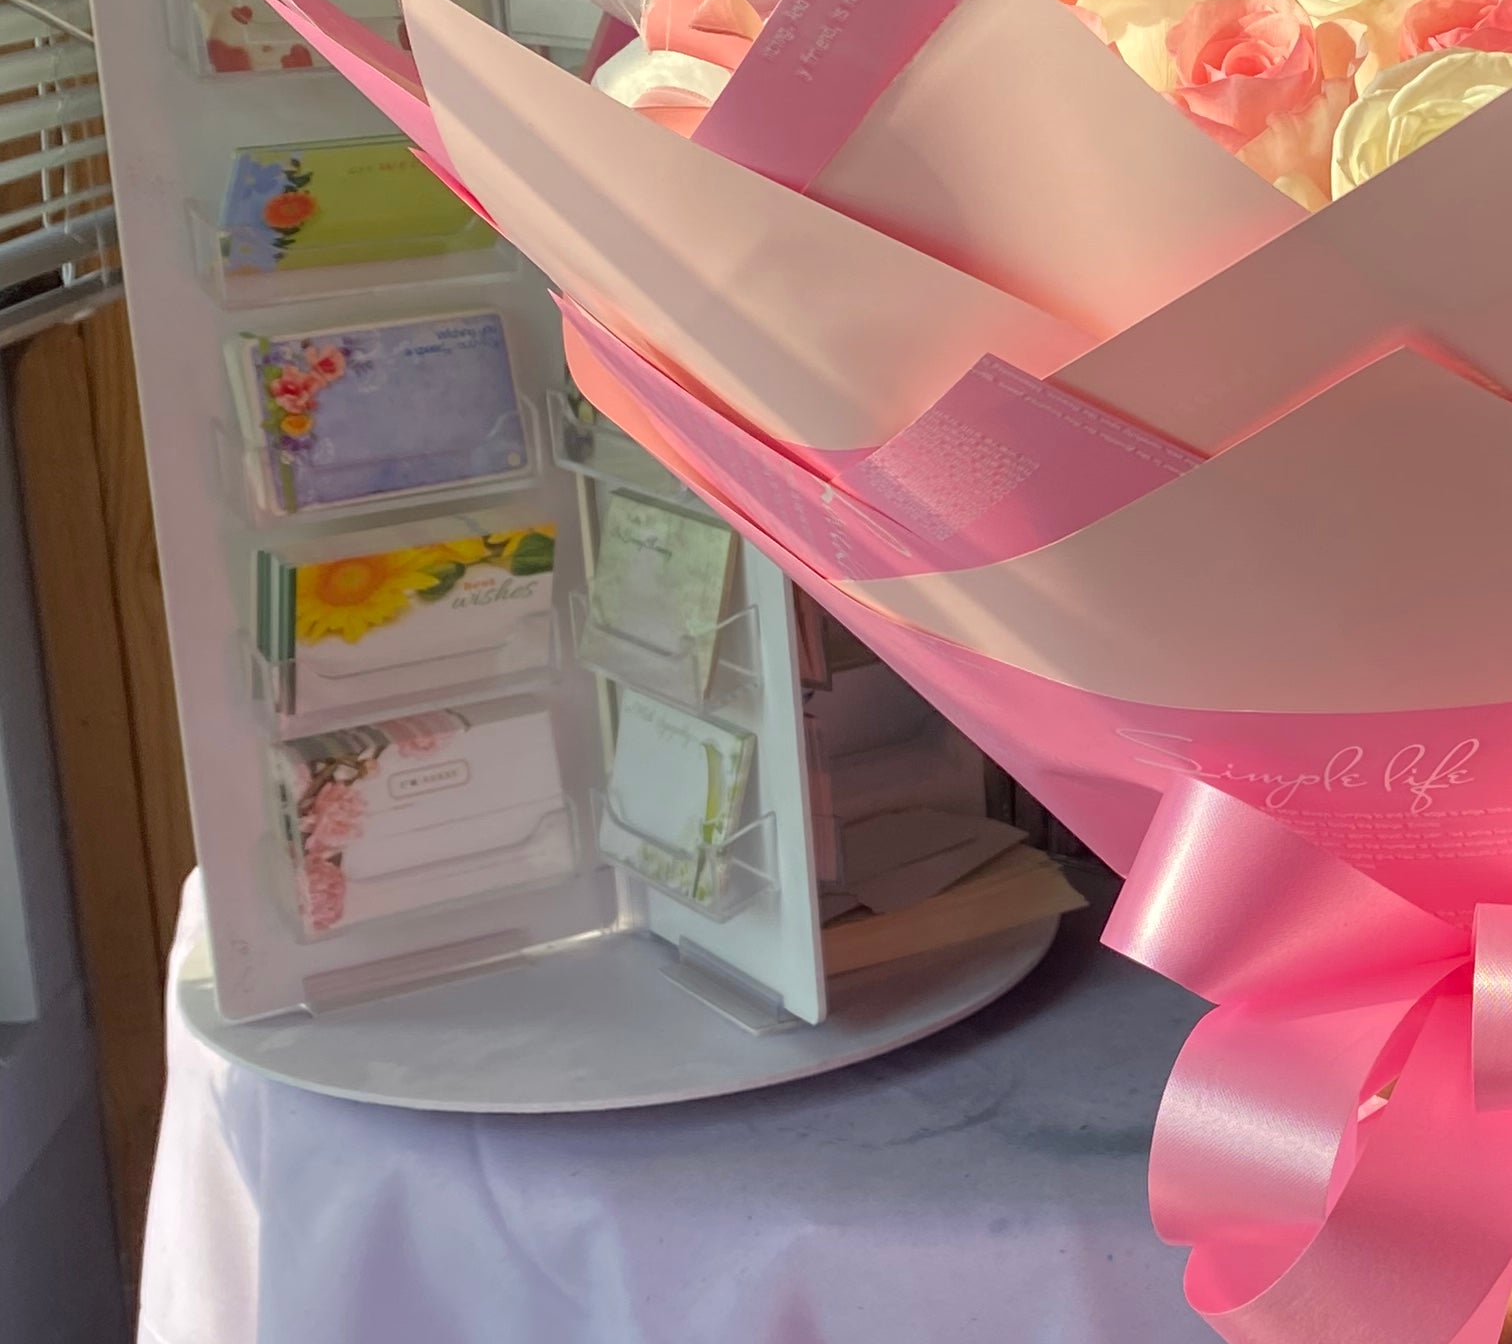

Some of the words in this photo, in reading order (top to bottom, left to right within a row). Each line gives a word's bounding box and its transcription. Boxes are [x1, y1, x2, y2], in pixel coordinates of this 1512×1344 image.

[450, 577, 539, 609] wishes
[1116, 728, 1367, 809] Simple
[1383, 738, 1481, 814] life
